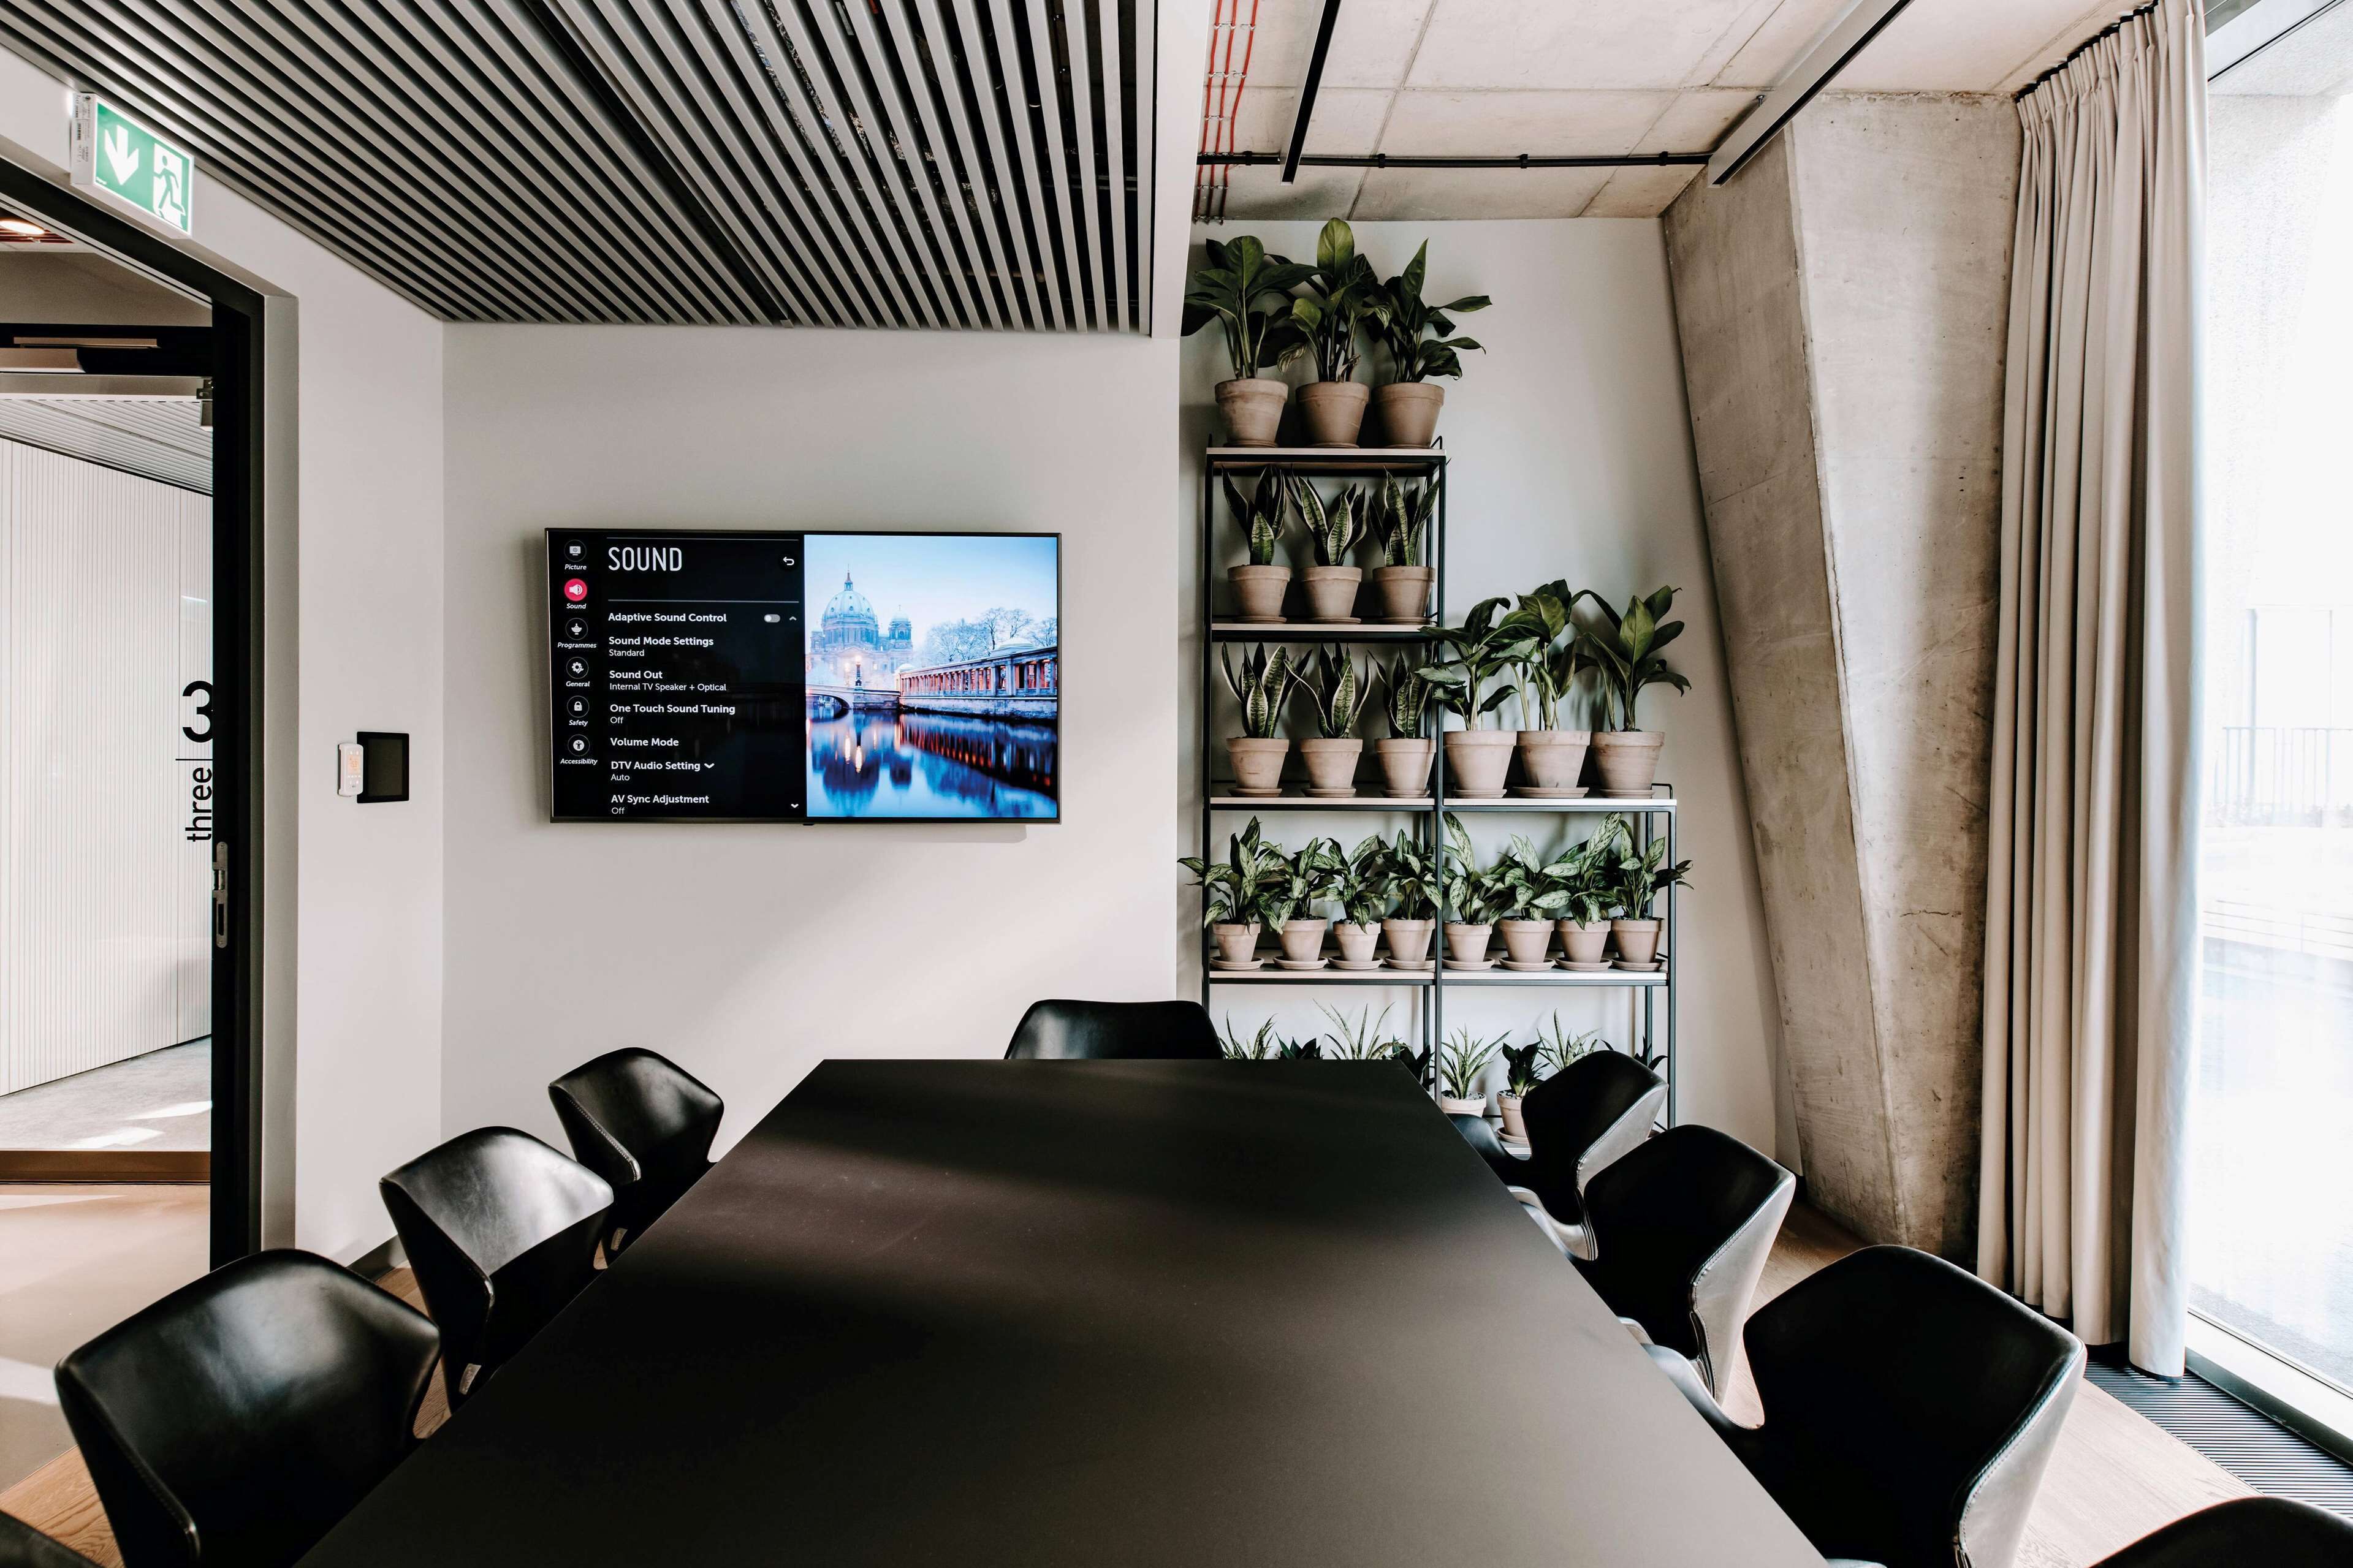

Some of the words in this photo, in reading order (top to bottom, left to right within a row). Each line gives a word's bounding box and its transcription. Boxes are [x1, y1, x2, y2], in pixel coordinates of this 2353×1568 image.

[608, 547, 682, 572] SOUND
[607, 612, 652, 623] Adaptive
[654, 613, 686, 622] Sound
[688, 613, 727, 623] Control
[609, 636, 641, 645] Sound
[643, 637, 671, 645] Mode
[673, 637, 714, 648] Settings
[609, 648, 645, 657] Standard
[609, 670, 641, 679] Sound
[643, 670, 663, 679] Out
[655, 683, 687, 692] Speaker
[697, 683, 727, 693] Optical
[183, 681, 216, 743] 3
[610, 703, 631, 713] One
[633, 704, 664, 713] Touch
[666, 704, 699, 713] Sound
[700, 704, 736, 716] Tuning
[610, 737, 649, 746] Volume
[651, 738, 679, 746] Mode
[611, 760, 632, 770] DTV
[633, 761, 663, 770] Audio
[665, 761, 701, 772] Setting
[185, 767, 213, 842] three
[610, 794, 625, 803] AV
[627, 795, 651, 805] Sync
[652, 795, 710, 805] Adjustment
